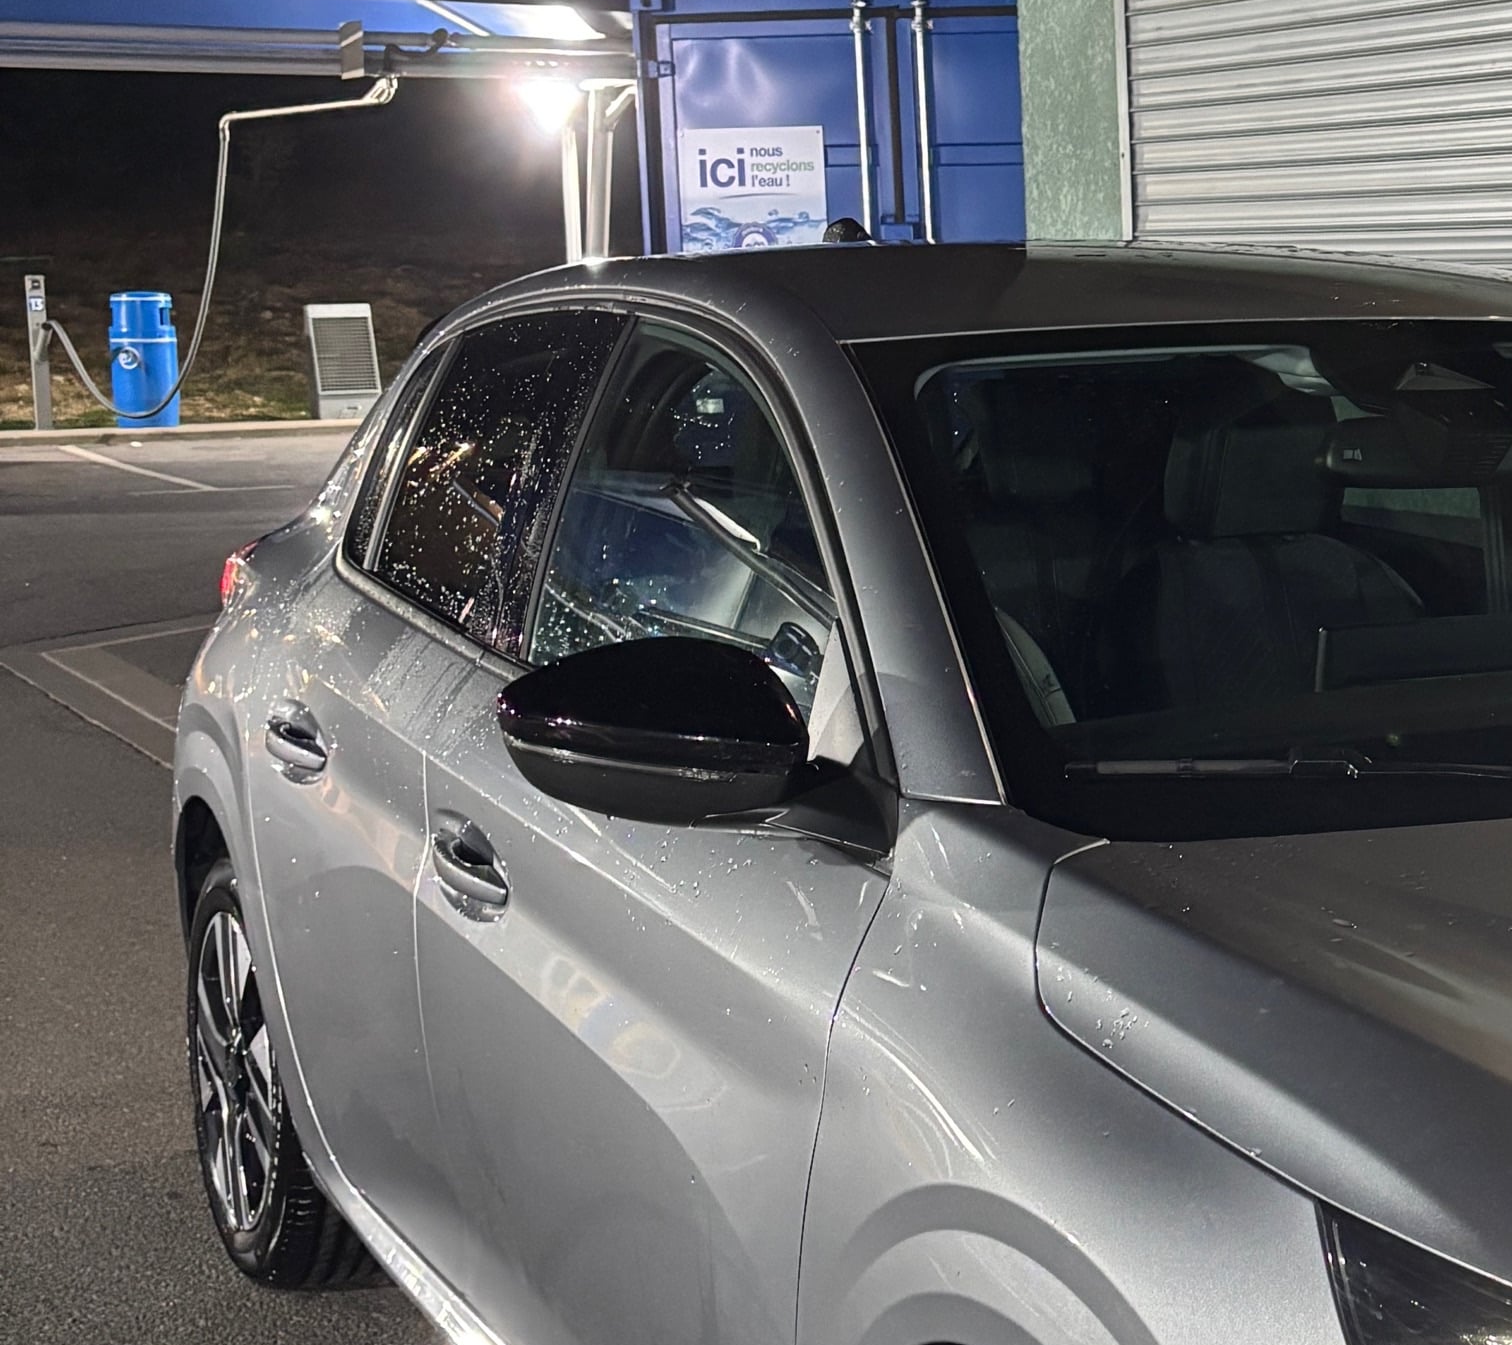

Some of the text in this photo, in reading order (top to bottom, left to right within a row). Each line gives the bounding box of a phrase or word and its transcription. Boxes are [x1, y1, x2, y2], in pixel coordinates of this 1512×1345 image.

[750, 146, 783, 158] nous
[698, 147, 746, 188] ici
[751, 159, 815, 175] recyclons
[751, 174, 783, 188] l'eau
